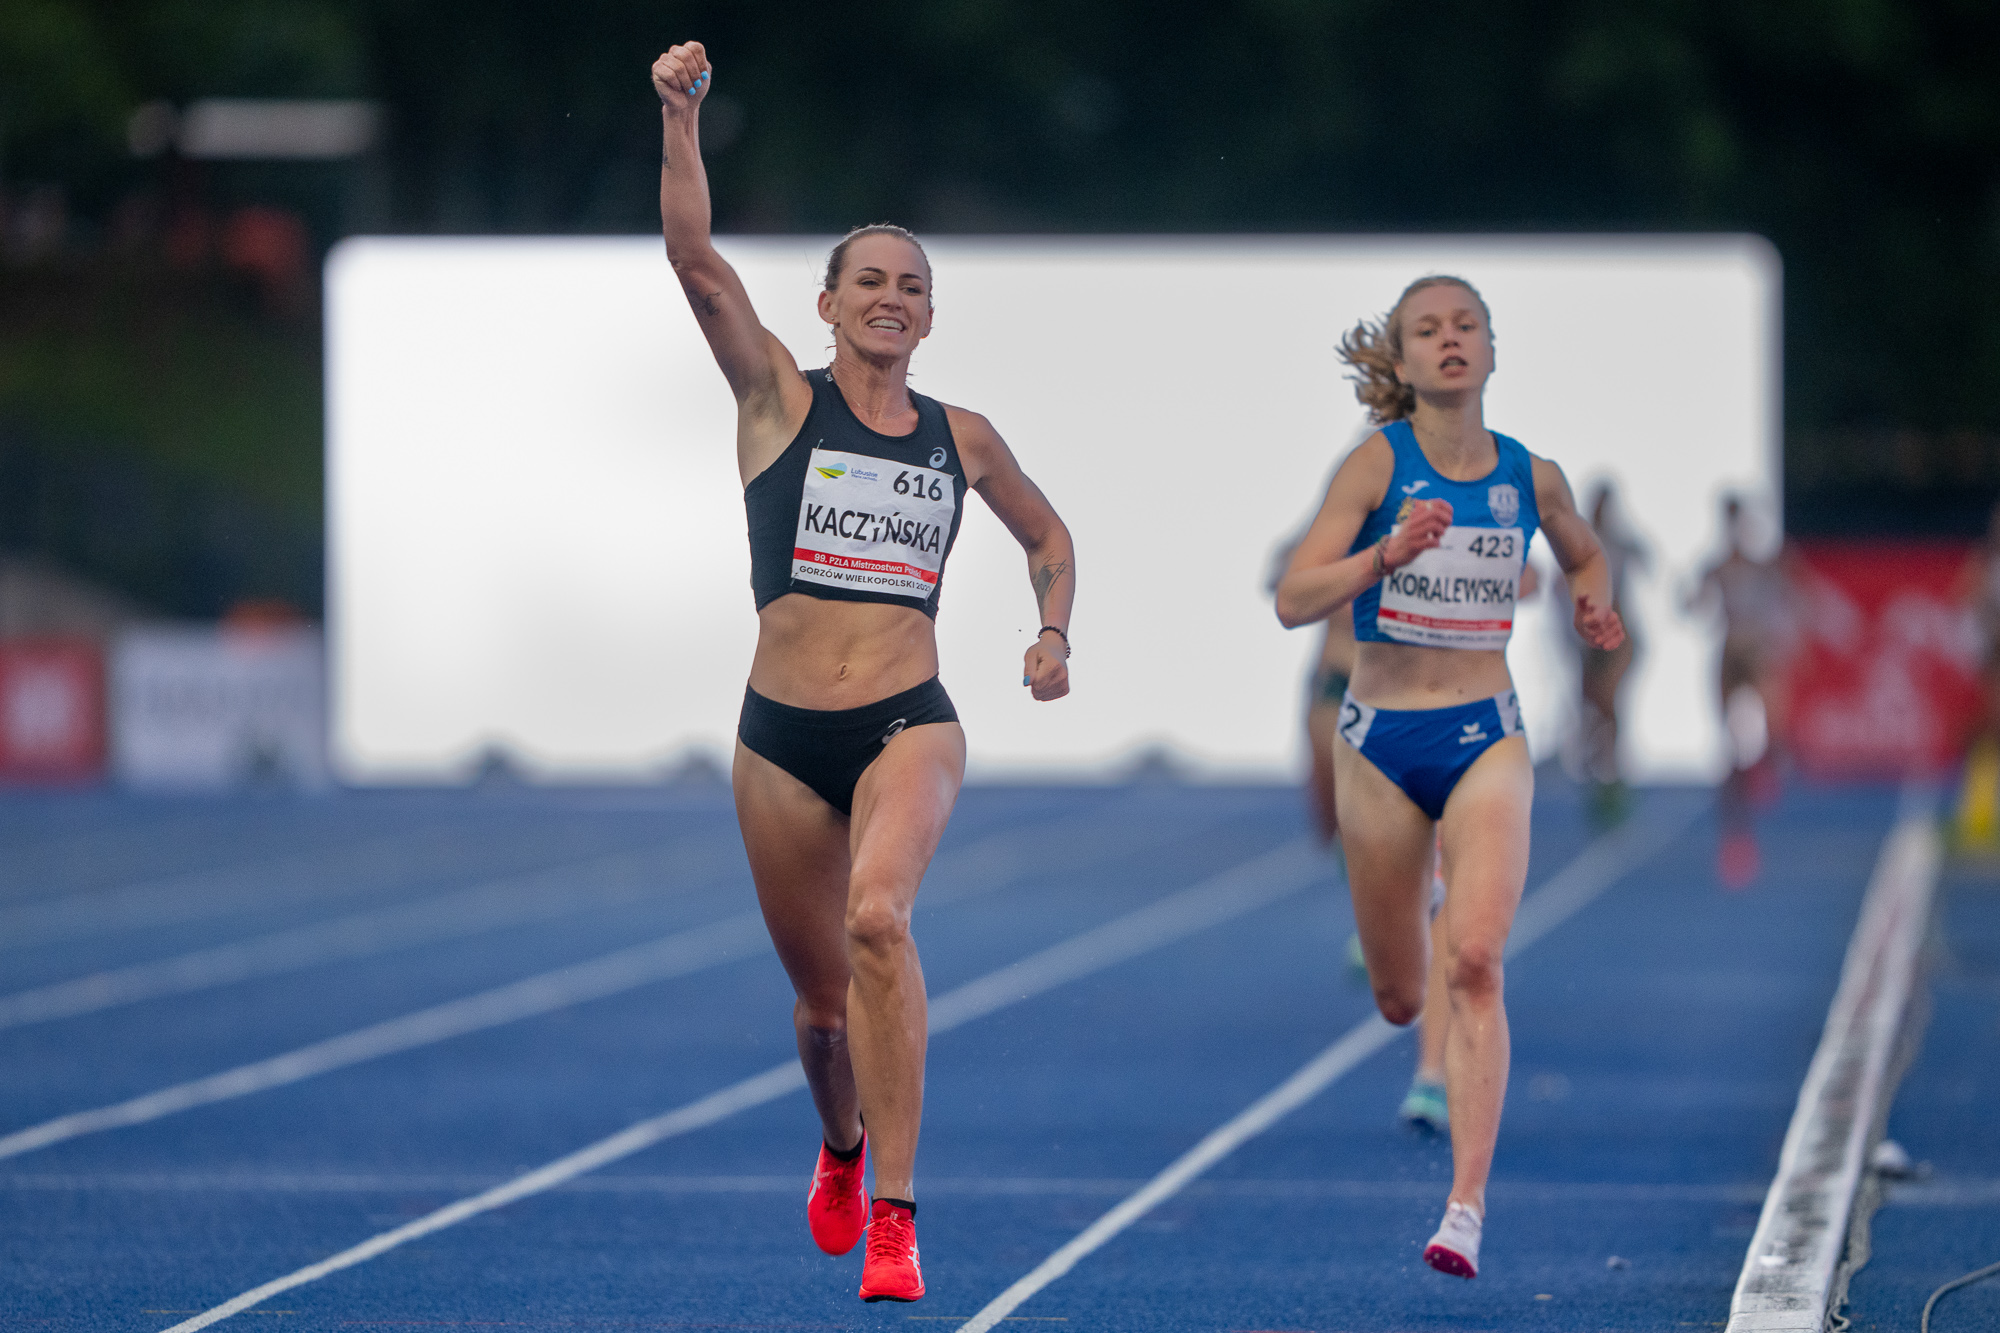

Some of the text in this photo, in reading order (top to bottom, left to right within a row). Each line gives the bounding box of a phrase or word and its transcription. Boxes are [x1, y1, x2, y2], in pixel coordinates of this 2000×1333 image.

[893, 470, 943, 502] 616
[804, 503, 941, 554] KACZYŃSKA
[1468, 535, 1515, 559] 423
[799, 565, 844, 581] GORZÓW
[845, 573, 915, 589] WIELKOPOLSKI
[814, 553, 922, 579] 99. PZLA Mistrzostwa Polski
[1388, 572, 1515, 603] KORALEWSKA
